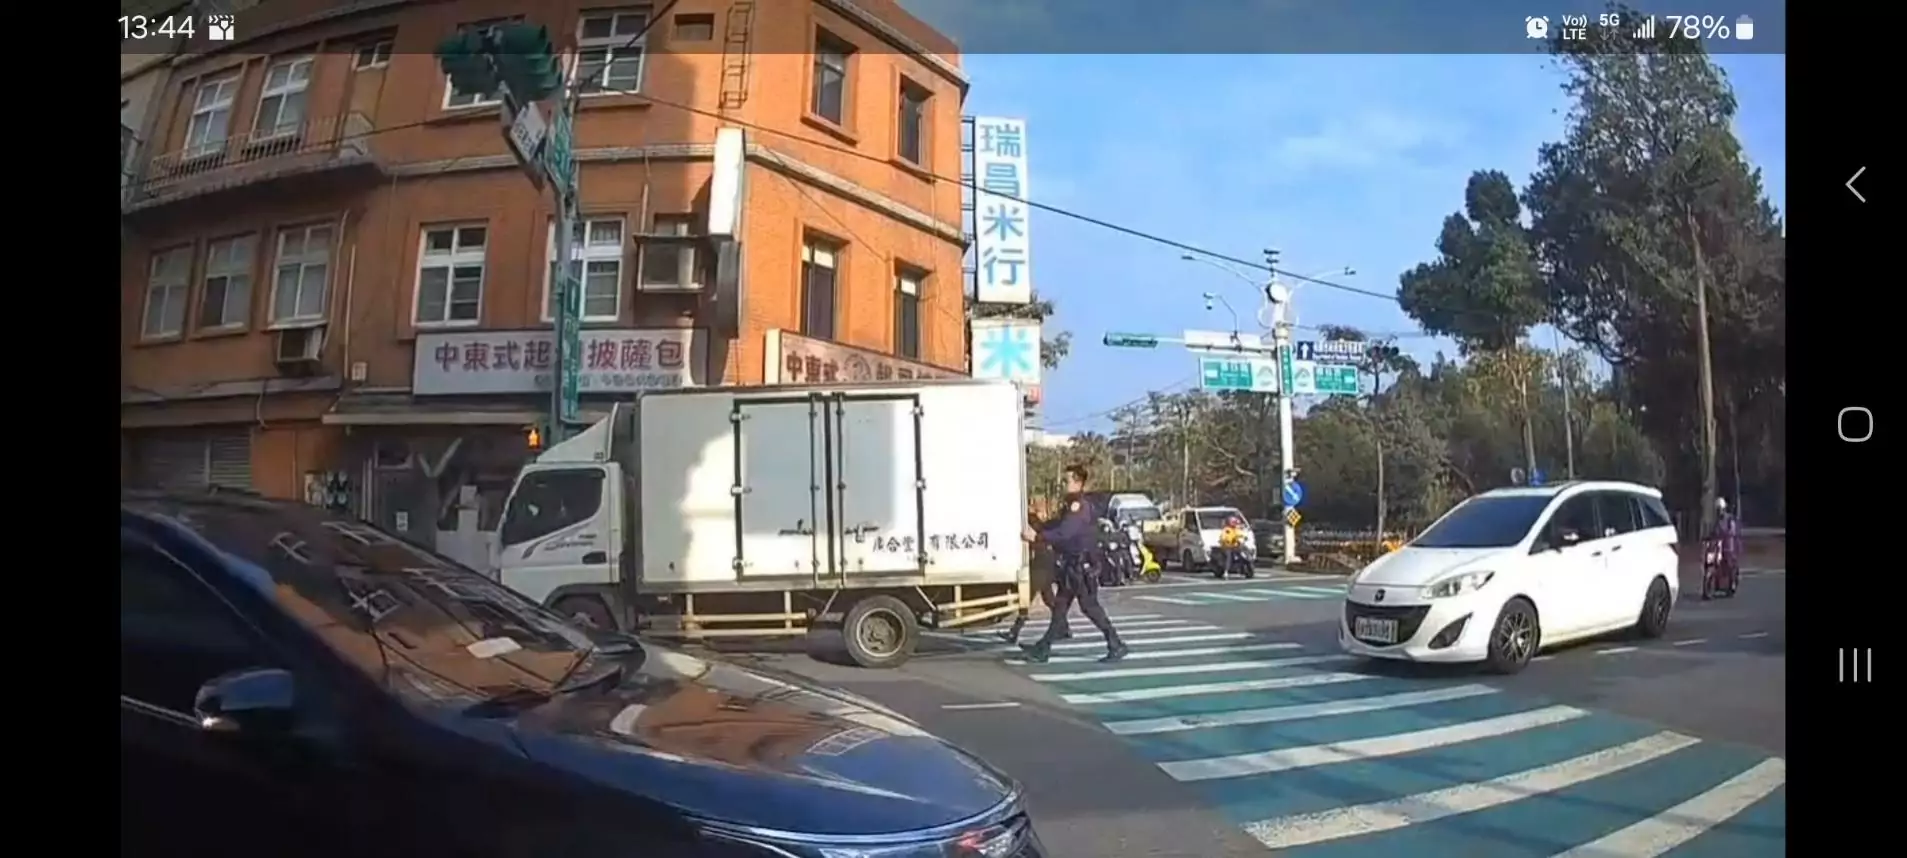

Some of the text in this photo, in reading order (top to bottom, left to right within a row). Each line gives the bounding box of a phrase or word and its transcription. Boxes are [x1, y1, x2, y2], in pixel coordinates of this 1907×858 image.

[979, 123, 1026, 286] 瑞昌米行
[435, 339, 685, 372] 中東式起披薩包
[786, 350, 840, 383] 中東式
[980, 324, 1033, 379] 米
